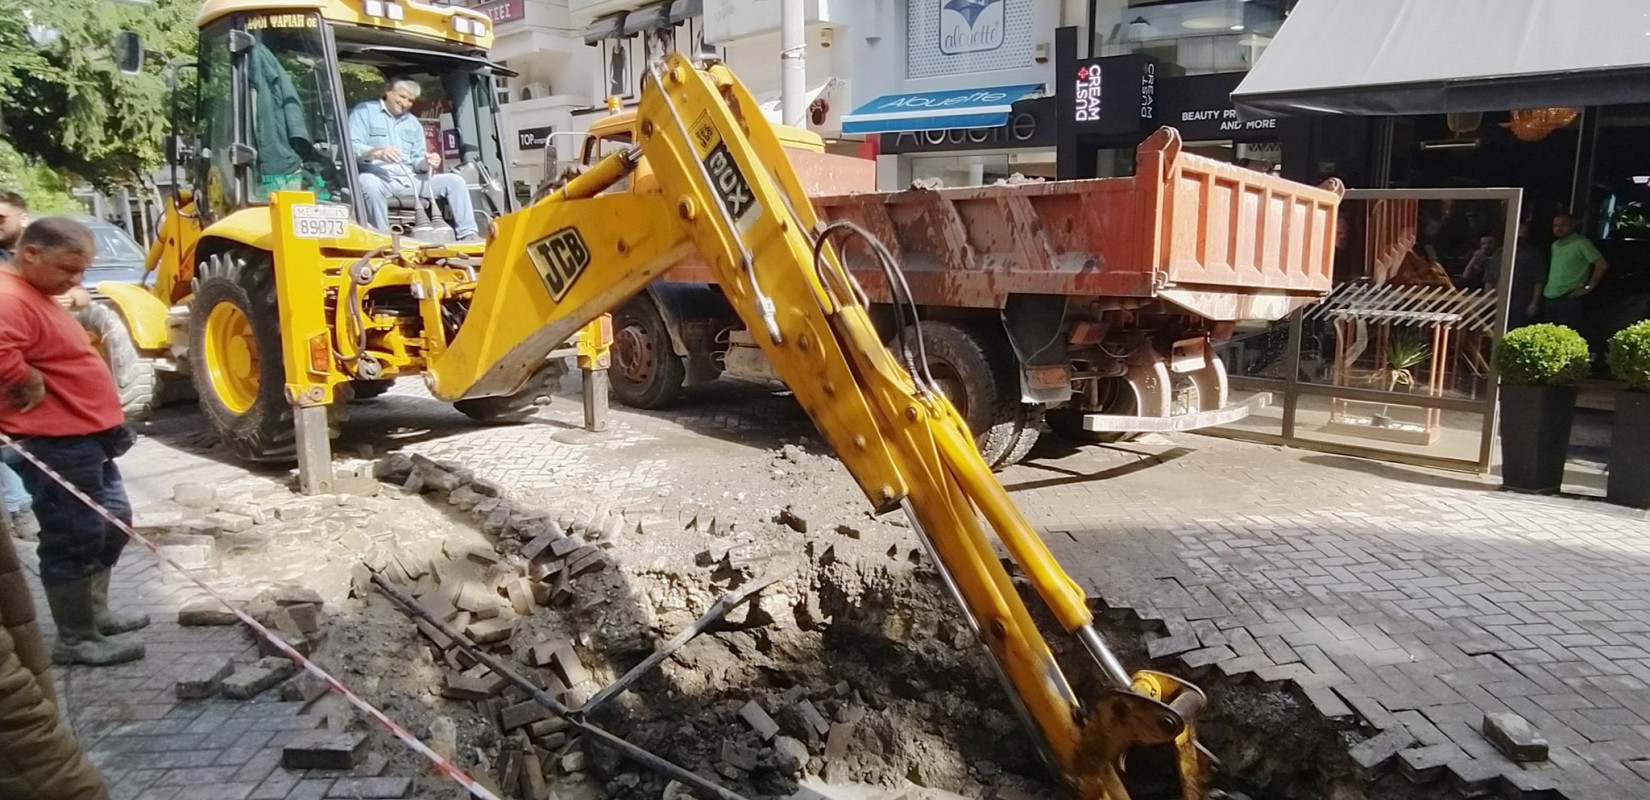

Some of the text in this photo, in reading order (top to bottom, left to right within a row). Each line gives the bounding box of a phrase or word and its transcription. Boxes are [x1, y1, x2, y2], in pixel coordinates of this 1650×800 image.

[944, 24, 998, 50] alouette
[1075, 79, 1088, 122] DUST
[1088, 64, 1101, 121] CREAM
[1146, 63, 1155, 119] CREAM
[1182, 109, 1237, 121] BEAUTY PR
[1220, 119, 1277, 131] AND MORE
[520, 133, 535, 146] TOP
[695, 123, 713, 149] JCB
[300, 219, 345, 235] 89073
[536, 231, 587, 295] JCB
